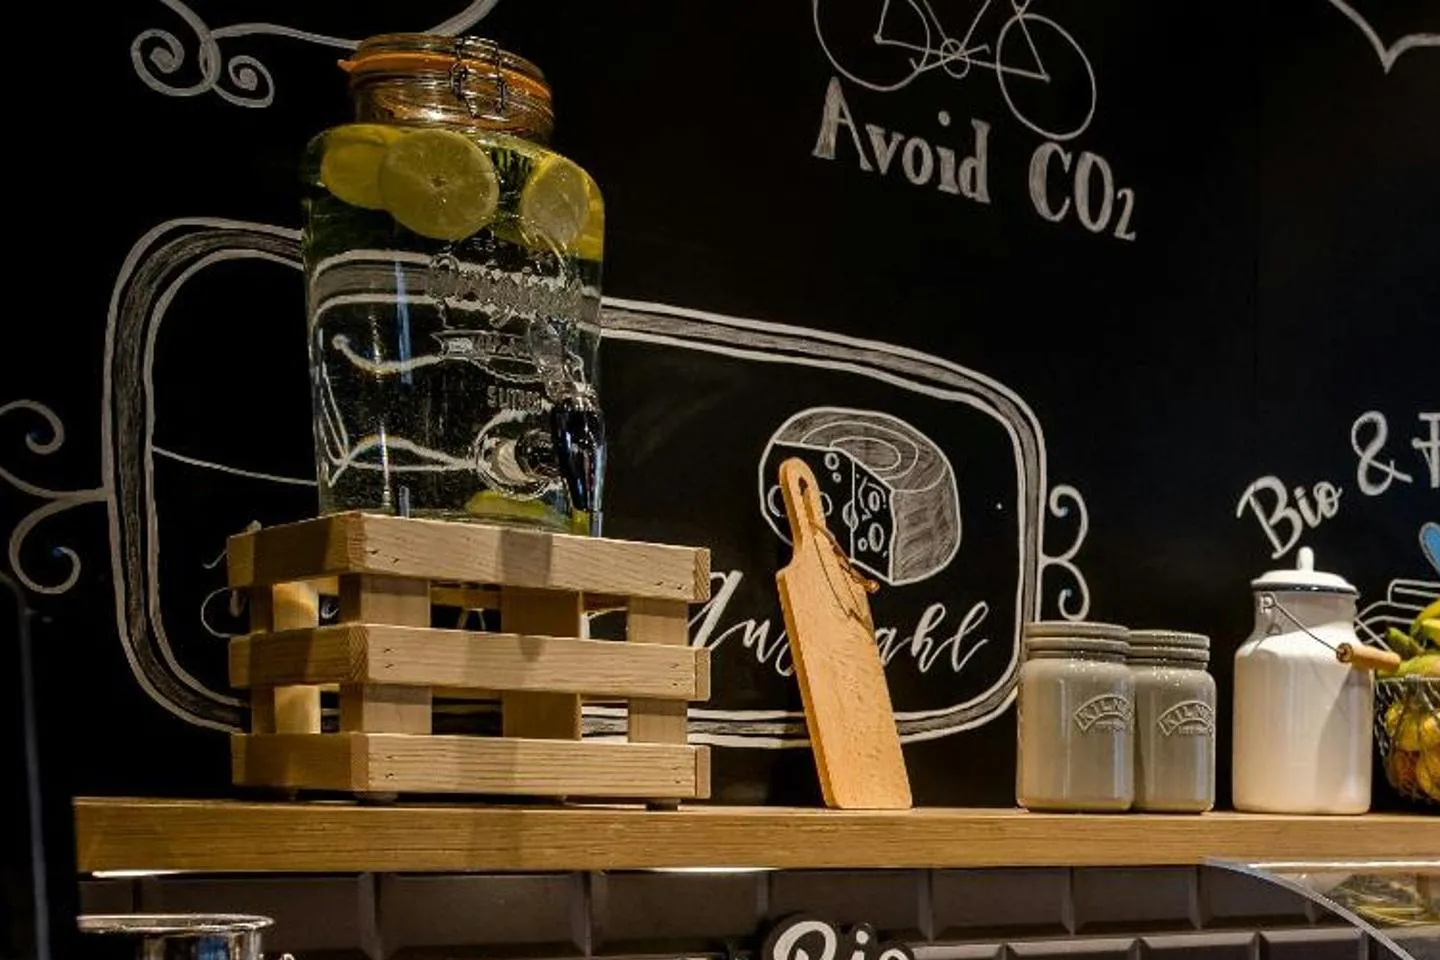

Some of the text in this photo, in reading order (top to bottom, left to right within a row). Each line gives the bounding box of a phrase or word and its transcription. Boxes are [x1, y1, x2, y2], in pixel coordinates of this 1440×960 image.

[812, 76, 992, 204] Avoid
[1236, 473, 1344, 561] Bio
[1350, 409, 1414, 498] &
